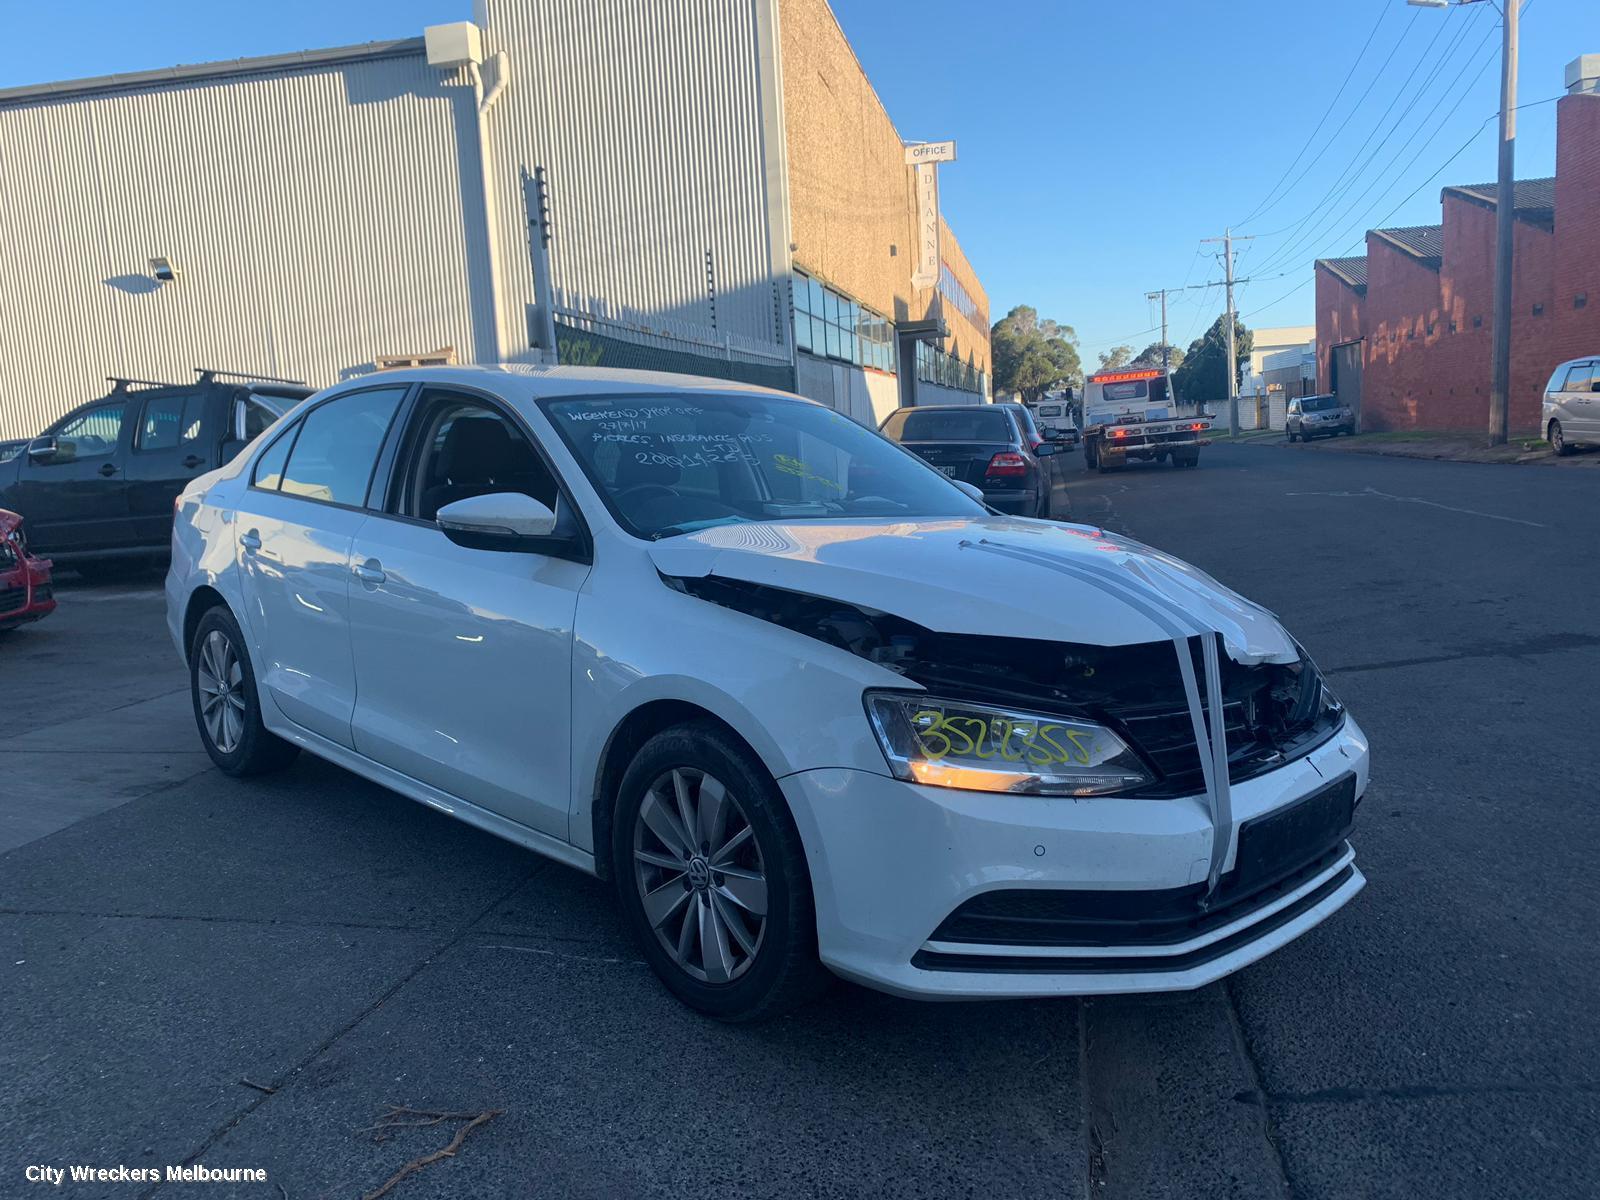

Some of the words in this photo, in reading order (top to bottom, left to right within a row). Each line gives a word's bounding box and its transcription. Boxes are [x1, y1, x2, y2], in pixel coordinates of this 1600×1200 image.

[912, 145, 946, 157] OFFICE
[924, 174, 936, 267] DIANNE
[568, 408, 639, 421] WEEKEND
